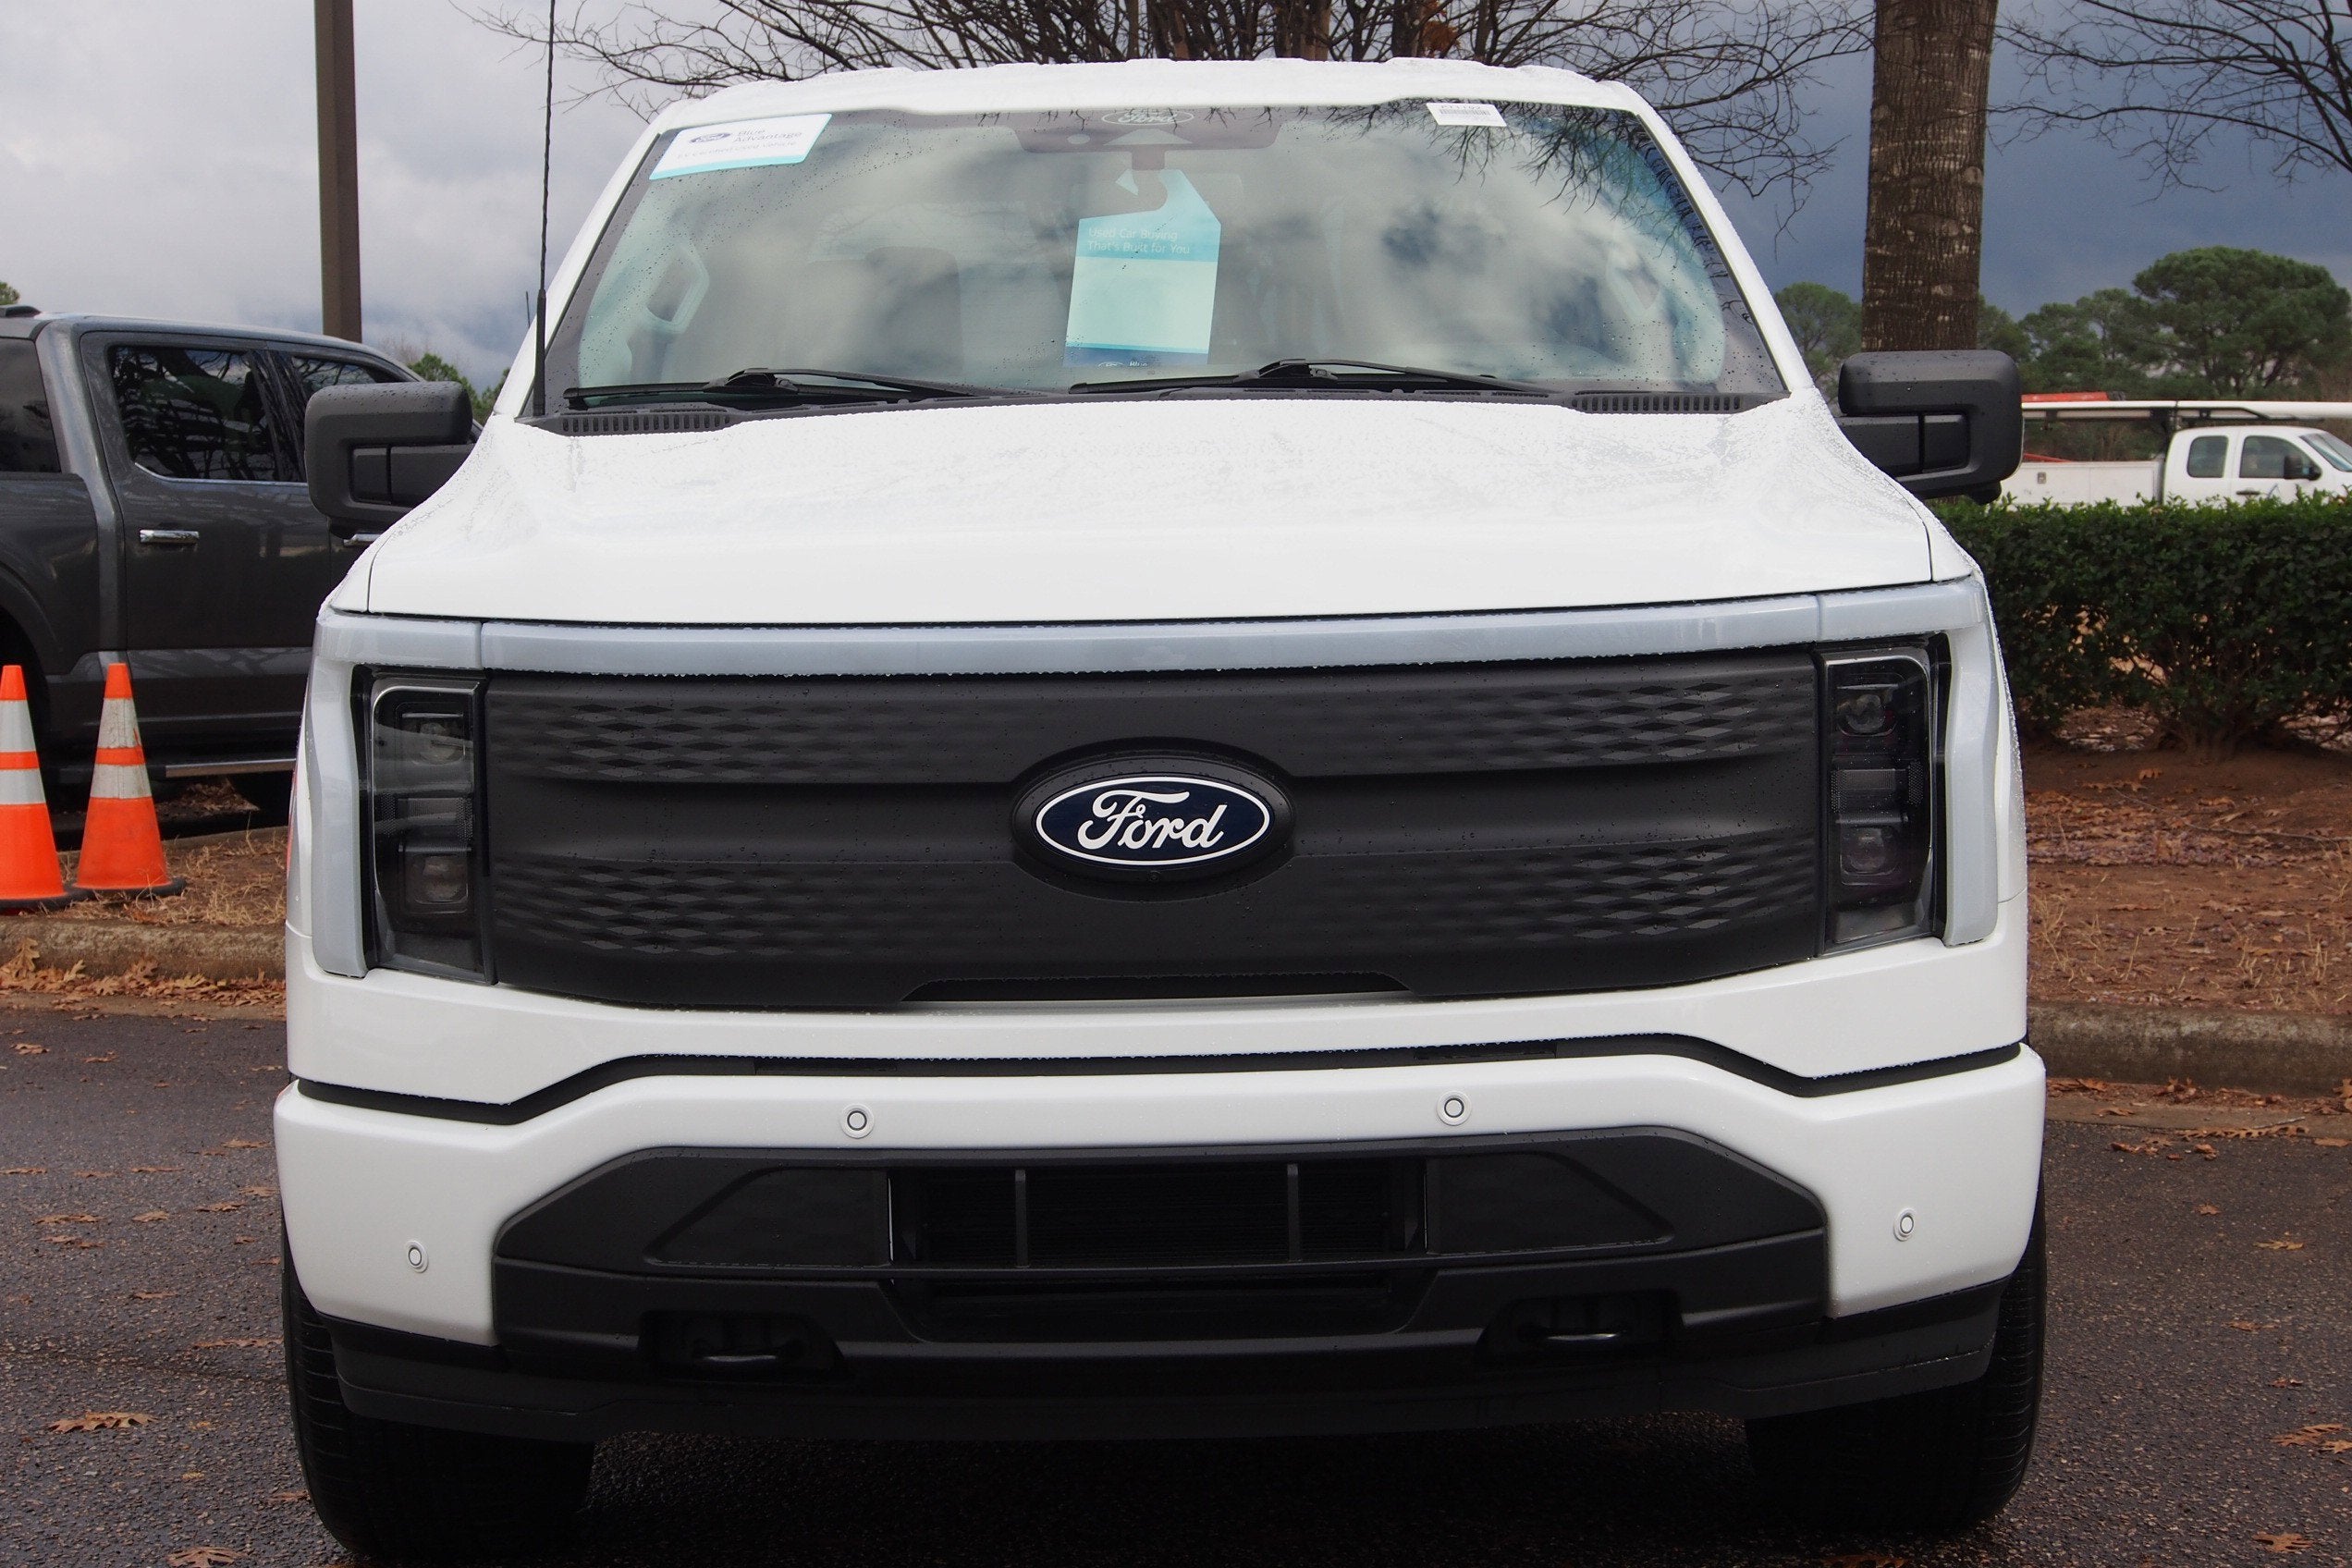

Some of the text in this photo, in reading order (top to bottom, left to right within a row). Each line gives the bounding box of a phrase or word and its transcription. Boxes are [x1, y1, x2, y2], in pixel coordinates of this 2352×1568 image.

[1118, 110, 1179, 124] Ford
[733, 131, 802, 143] Advantage
[1088, 227, 1178, 242] Used Car Buying
[1087, 240, 1190, 254] That's Built for You
[1077, 789, 1228, 850] Ford
